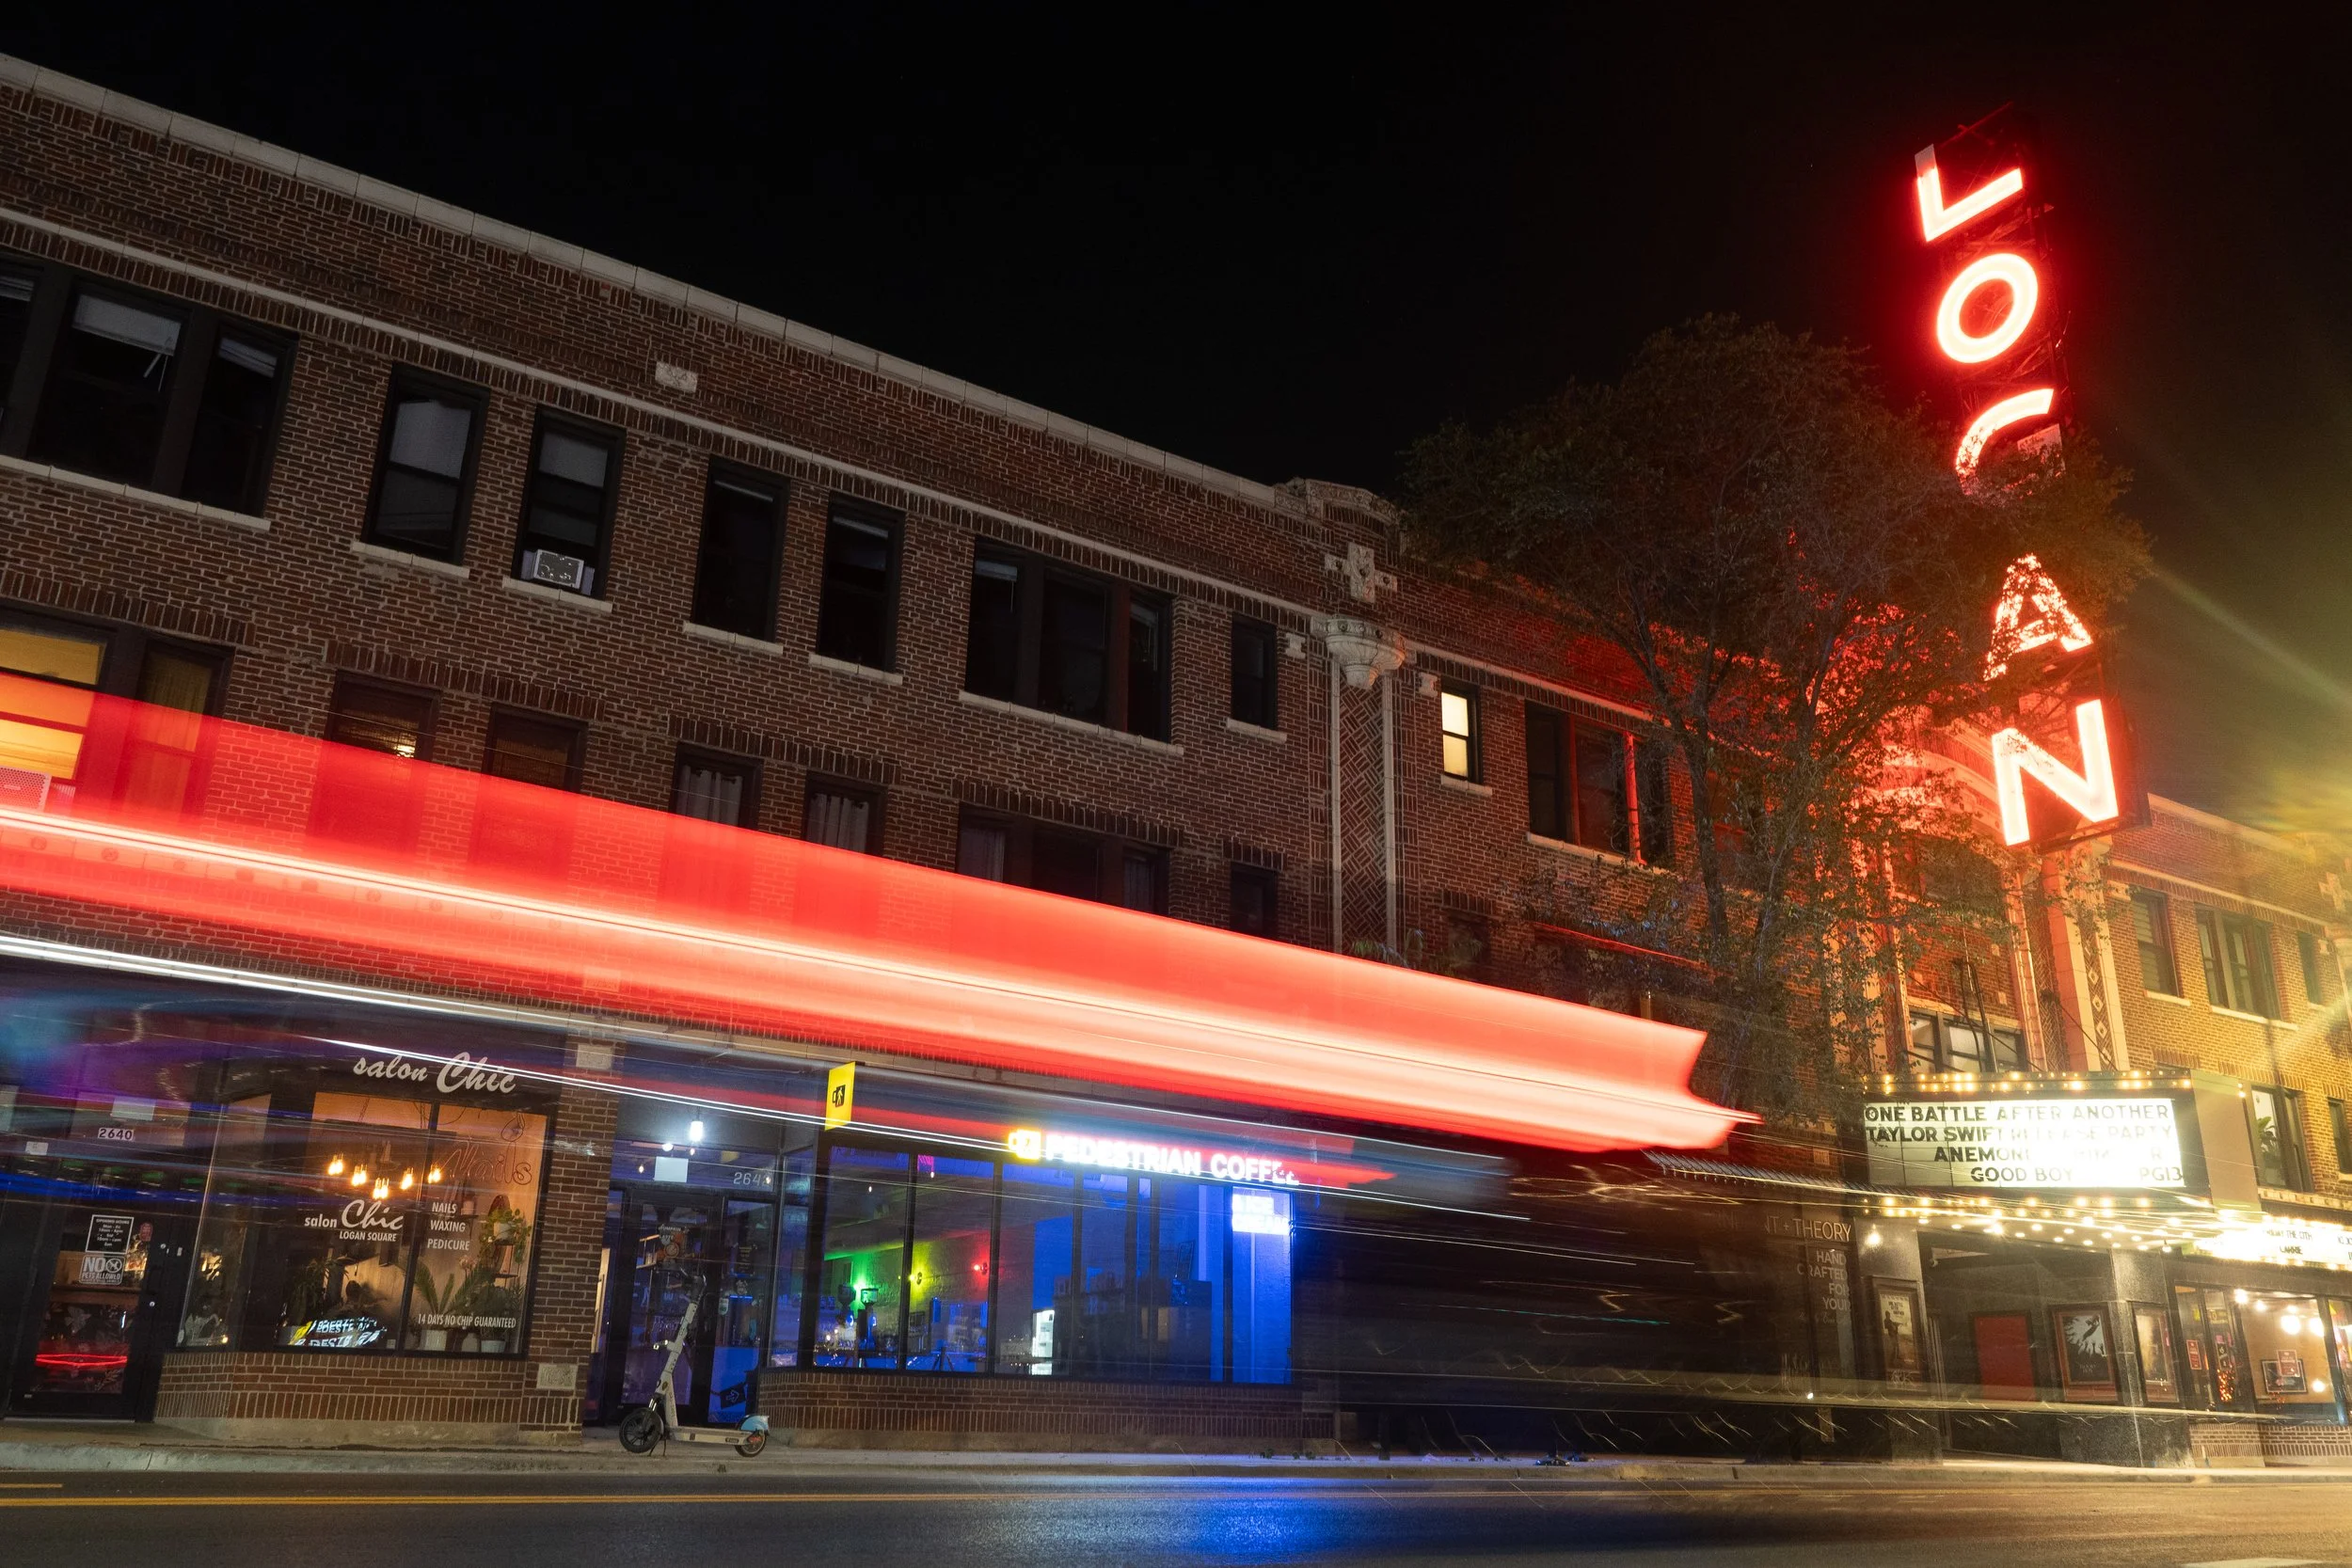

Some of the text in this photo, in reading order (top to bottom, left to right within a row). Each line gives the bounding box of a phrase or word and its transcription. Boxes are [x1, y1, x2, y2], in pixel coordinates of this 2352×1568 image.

[353, 1051, 516, 1093] salon Chic
[1865, 1103, 2169, 1122] ONE BATTLE AFTER ANOTHER
[99, 1128, 133, 1140] 2640
[1866, 1126, 1939, 1142] TAYLOR
[1944, 1126, 2004, 1142] SWIFT
[1045, 1132, 1201, 1176] PEDESTRIAN
[1970, 1166, 2184, 1182] GOOD BOY PG13
[304, 1199, 405, 1230] salon Chic
[431, 1201, 458, 1214] NAILS
[430, 1220, 466, 1232] WAXING
[1792, 1218, 1851, 1243] THEORY
[340, 1230, 397, 1242] LOGAN SQUARE
[426, 1238, 470, 1252] PEDICURE
[83, 1257, 105, 1273] NO
[1816, 1250, 1847, 1266] HAND
[96, 1272, 121, 1280] ALLOWED
[1797, 1262, 1849, 1281] CRAFTED
[418, 1313, 516, 1329] 14 DAYS NO CHIP GUARANTEED
